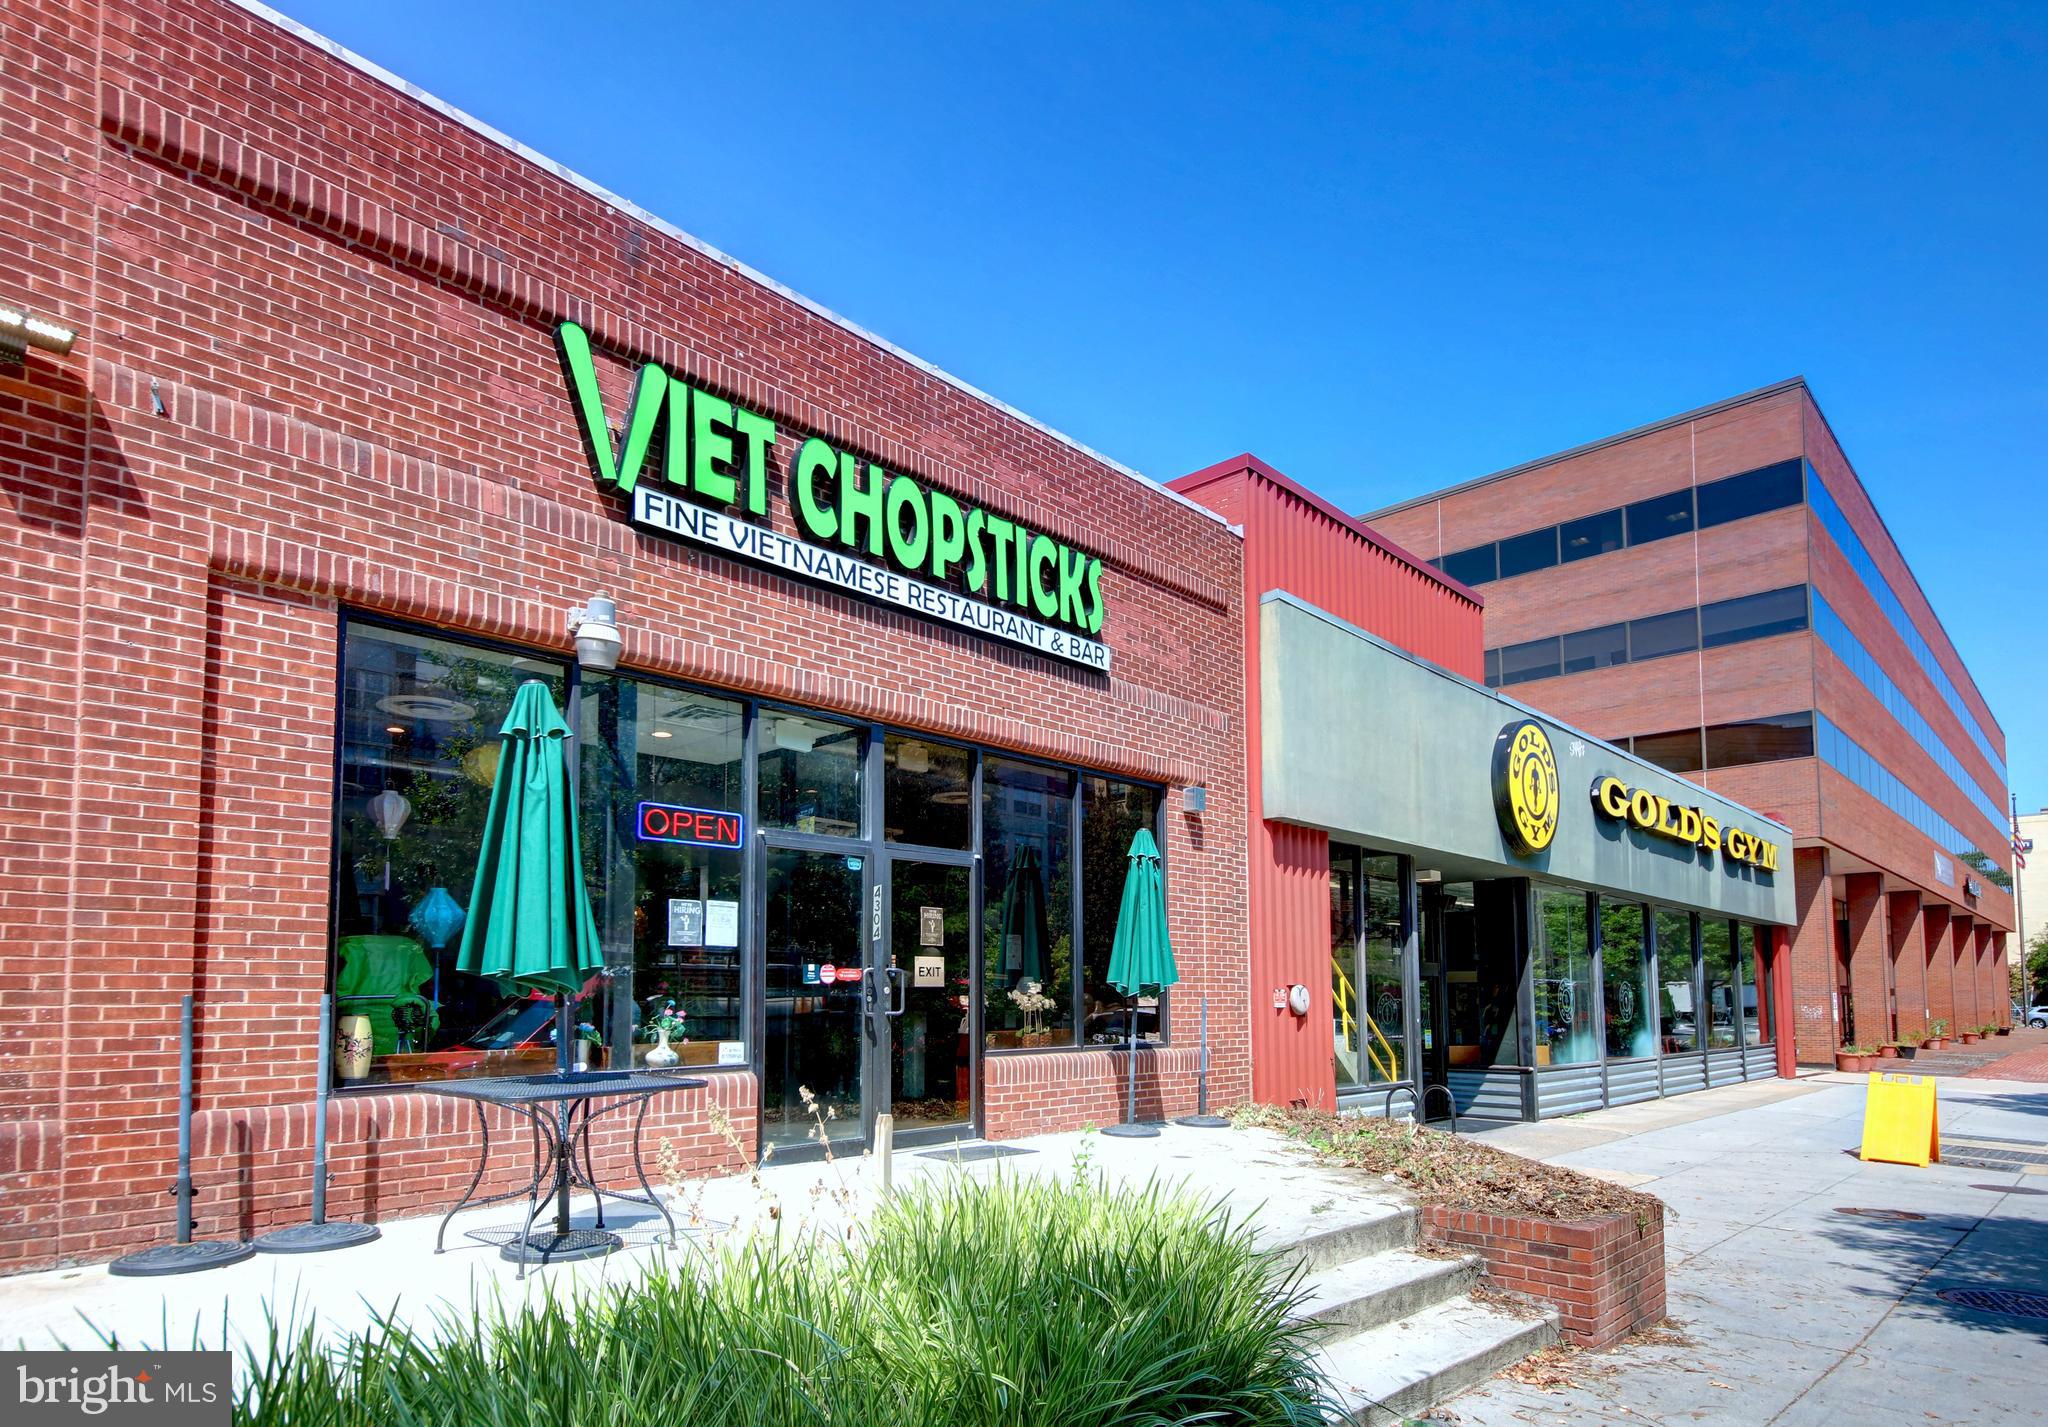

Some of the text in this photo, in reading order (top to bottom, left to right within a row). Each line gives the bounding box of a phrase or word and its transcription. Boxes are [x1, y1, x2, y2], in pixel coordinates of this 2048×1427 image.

[557, 321, 1103, 635] VIET CHOPSTICKS
[643, 493, 1106, 668] FINE VIETNAMESE RESTAURANT & BAR
[1513, 729, 1557, 841] GOLD'S GYM
[644, 808, 739, 843] OPEN
[1598, 776, 1780, 872] GOLD'S GYM
[673, 905, 701, 915] HIRING
[873, 886, 882, 939] 4304
[918, 966, 942, 977] EXIT
